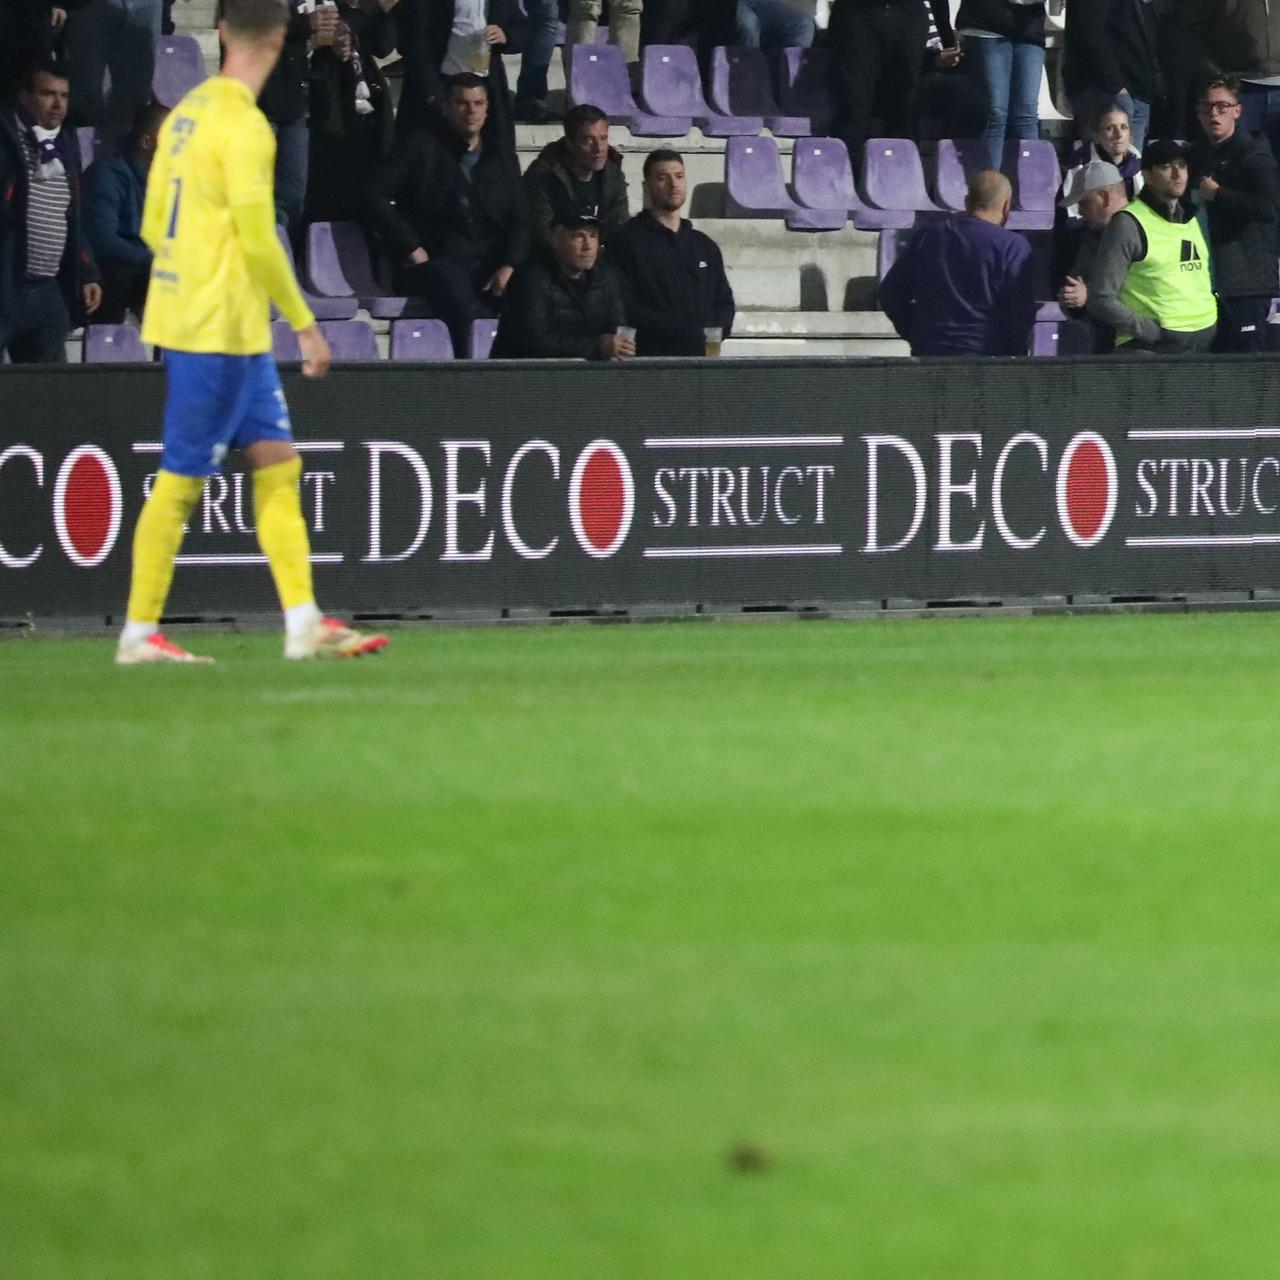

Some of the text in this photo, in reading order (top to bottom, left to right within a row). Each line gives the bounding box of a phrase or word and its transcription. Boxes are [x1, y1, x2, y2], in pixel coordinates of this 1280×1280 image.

[361, 438, 635, 563] DECO
[652, 465, 836, 527] STRUCT
[861, 430, 1119, 554] DECO
